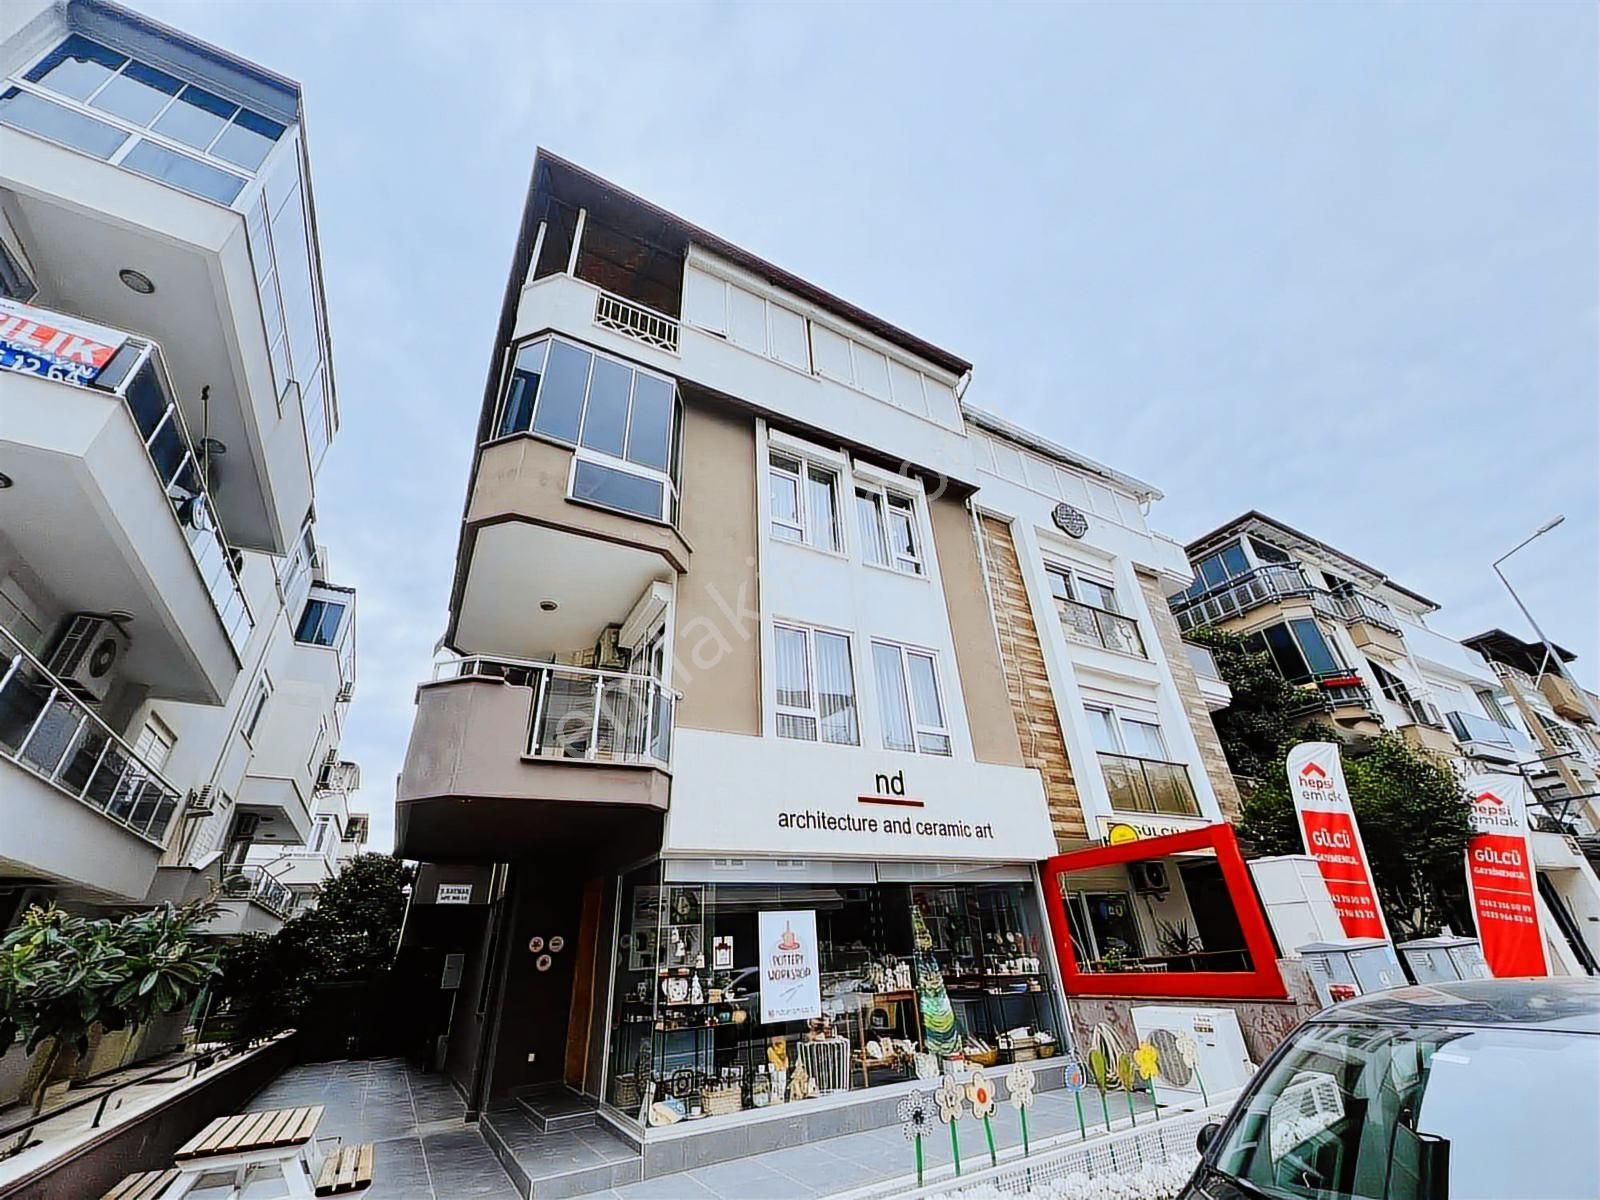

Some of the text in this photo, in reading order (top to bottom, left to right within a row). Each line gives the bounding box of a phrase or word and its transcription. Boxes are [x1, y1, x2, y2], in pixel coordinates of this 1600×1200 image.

[875, 770, 905, 795] nd
[1298, 776, 1334, 791] hepsi
[778, 810, 994, 839] architecture and ceramic art
[1469, 815, 1520, 828] emlak
[1312, 828, 1351, 848] GÜLCÜ
[1474, 847, 1521, 866] GÜLCÜ
